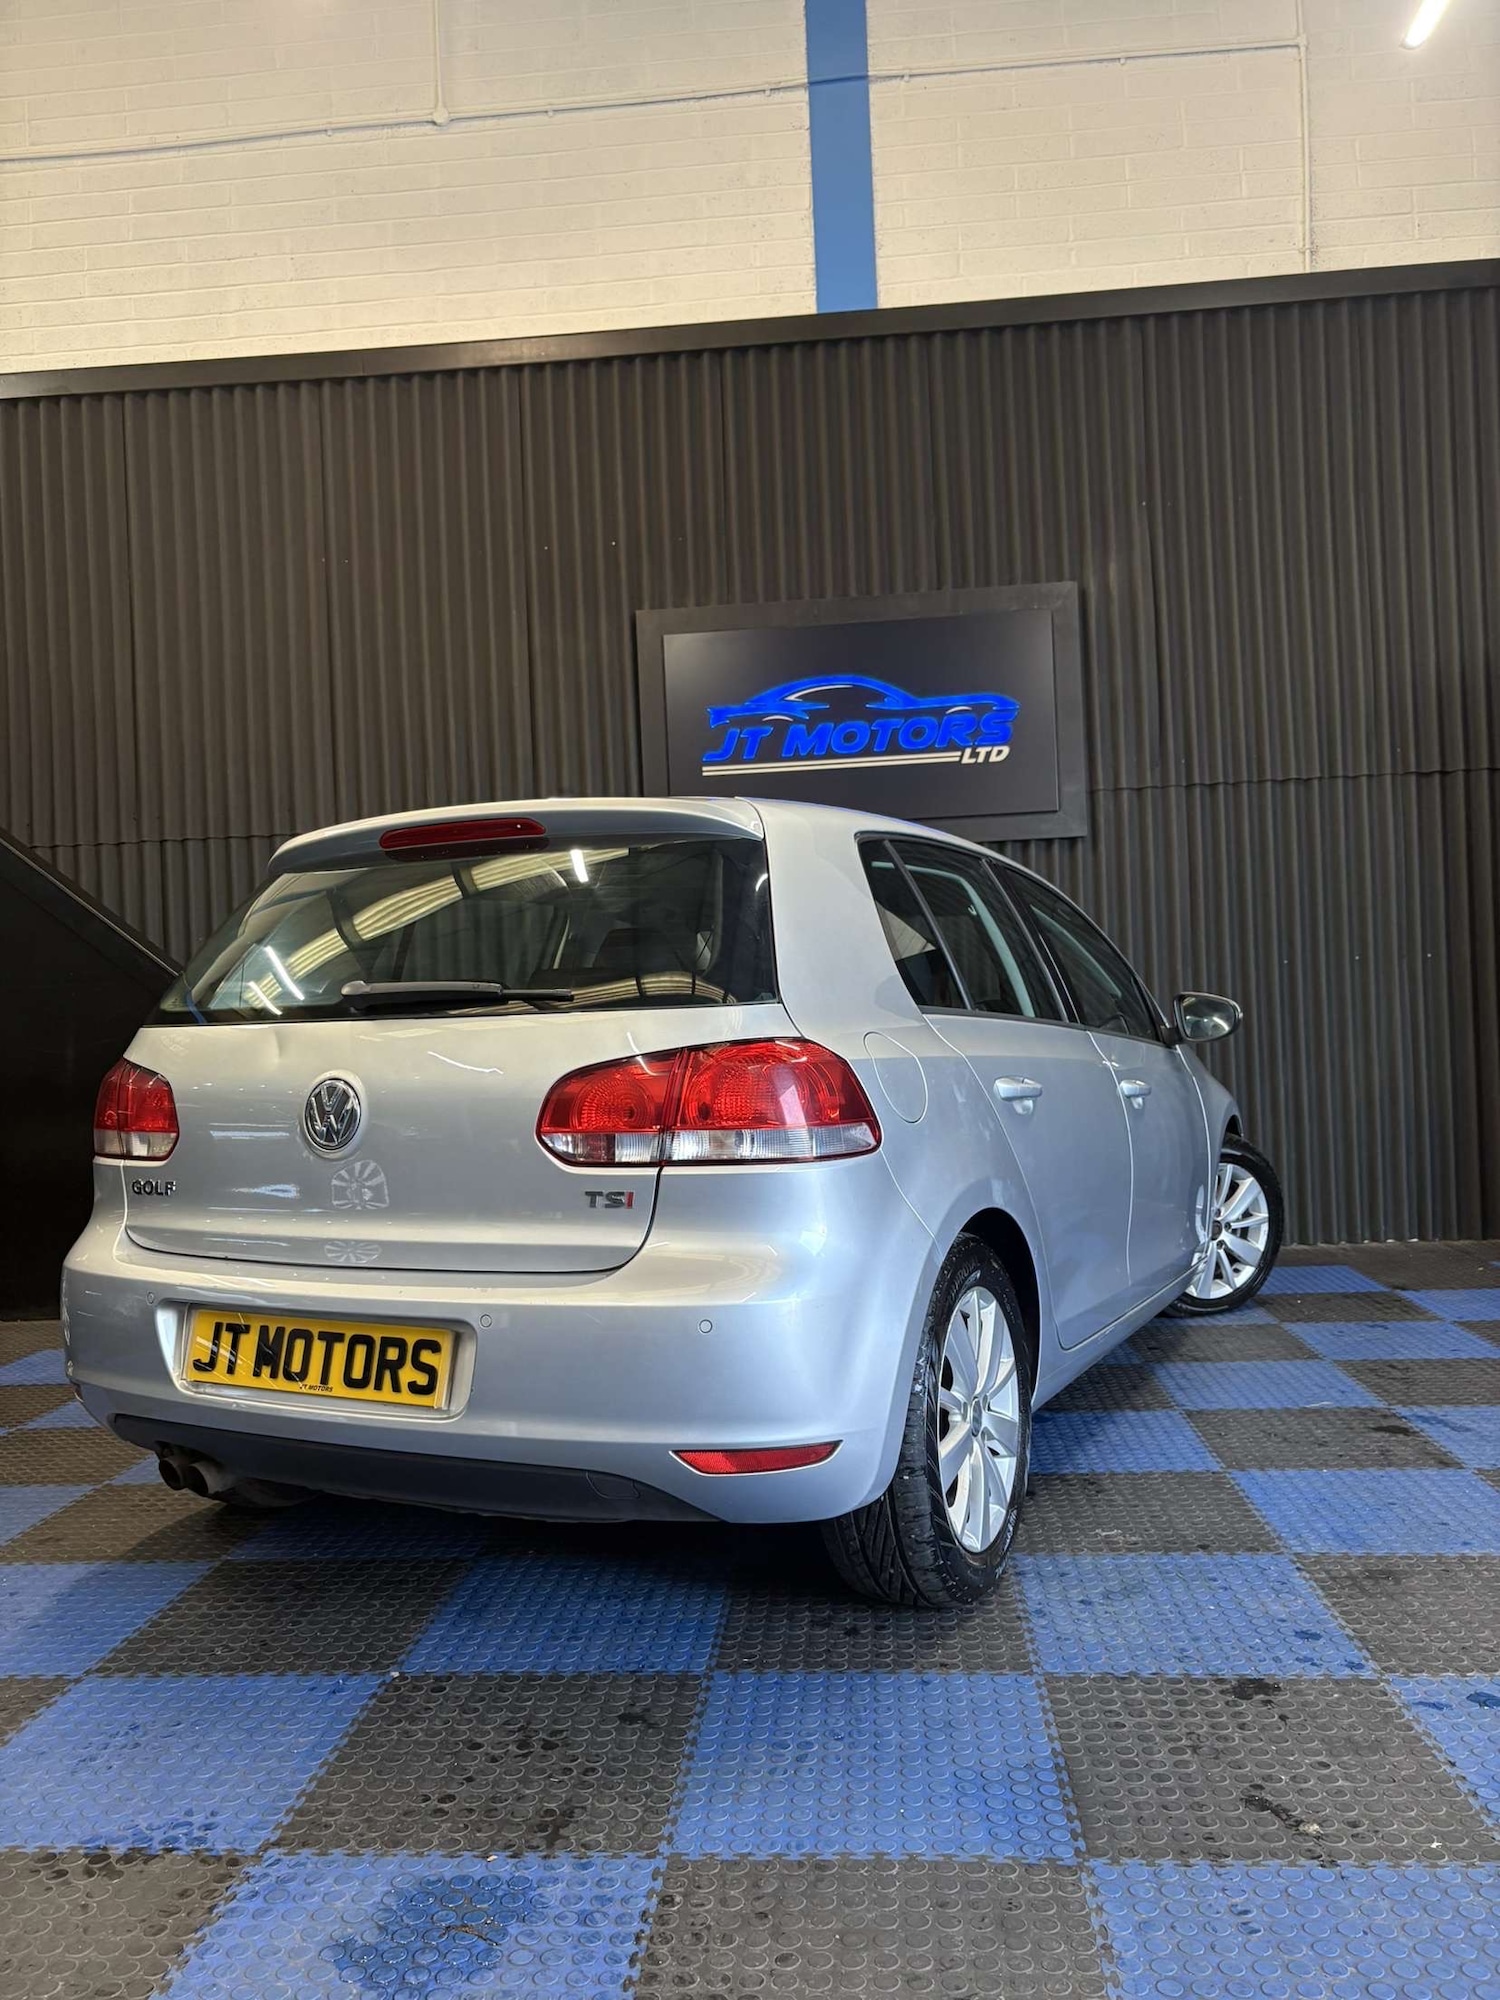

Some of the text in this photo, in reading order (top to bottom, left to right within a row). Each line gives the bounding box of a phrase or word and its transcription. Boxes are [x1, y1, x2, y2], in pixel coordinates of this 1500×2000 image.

[702, 711, 1020, 762] JT MOTORS
[961, 745, 1010, 764] LTD
[132, 1180, 176, 1196] GOLF
[193, 1321, 442, 1396] JT MOTORS
[309, 1384, 333, 1392] MOTORS
